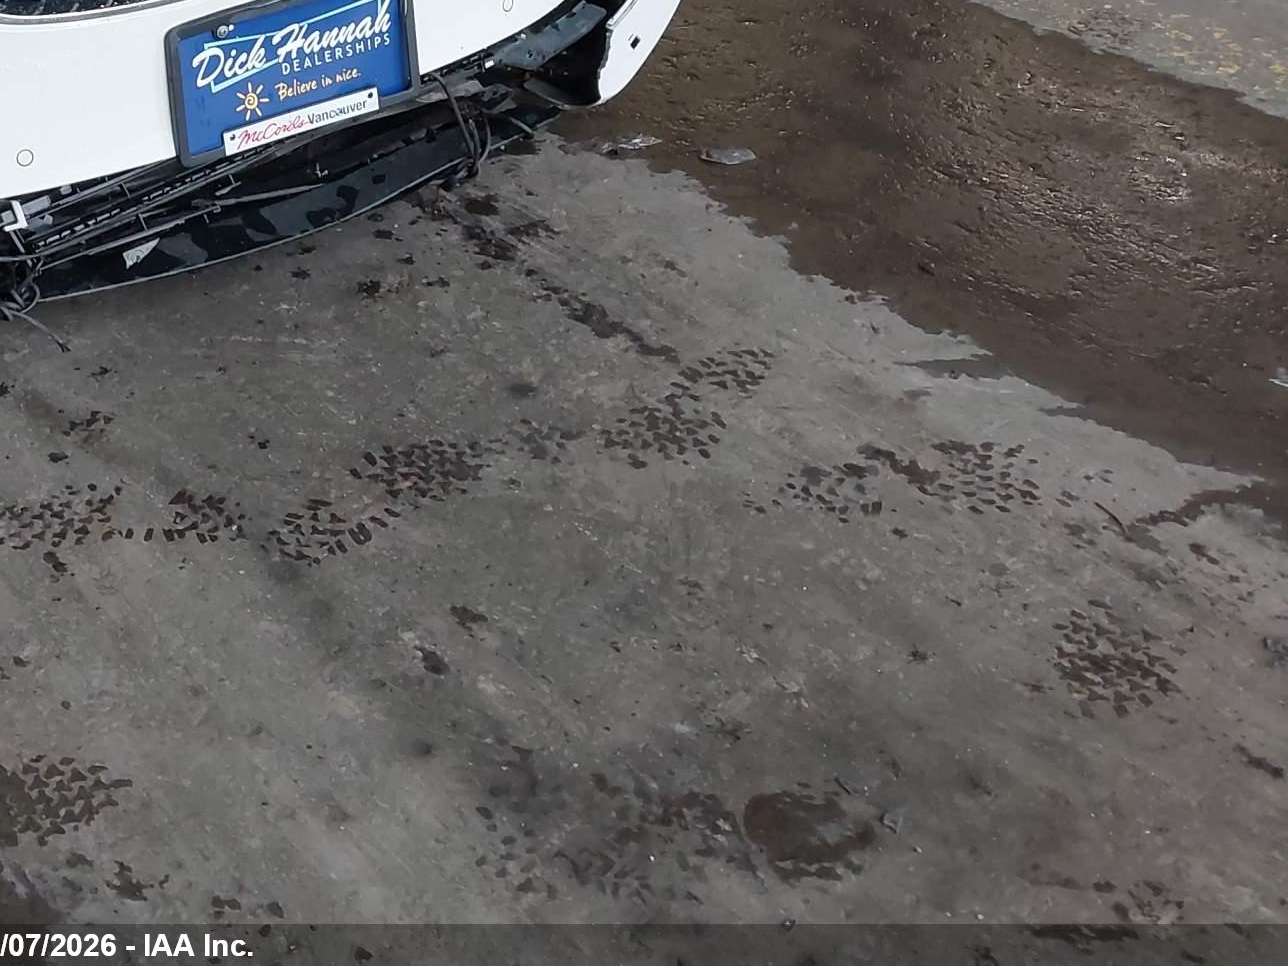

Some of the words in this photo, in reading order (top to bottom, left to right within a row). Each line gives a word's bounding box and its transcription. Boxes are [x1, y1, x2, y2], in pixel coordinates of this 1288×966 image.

[192, 34, 266, 88] Dick
[281, 33, 391, 75] DEALERSHIPS
[275, 78, 318, 101] Believe
[321, 74, 333, 86] in
[336, 67, 361, 83] nice.
[307, 98, 368, 125] Vancouver
